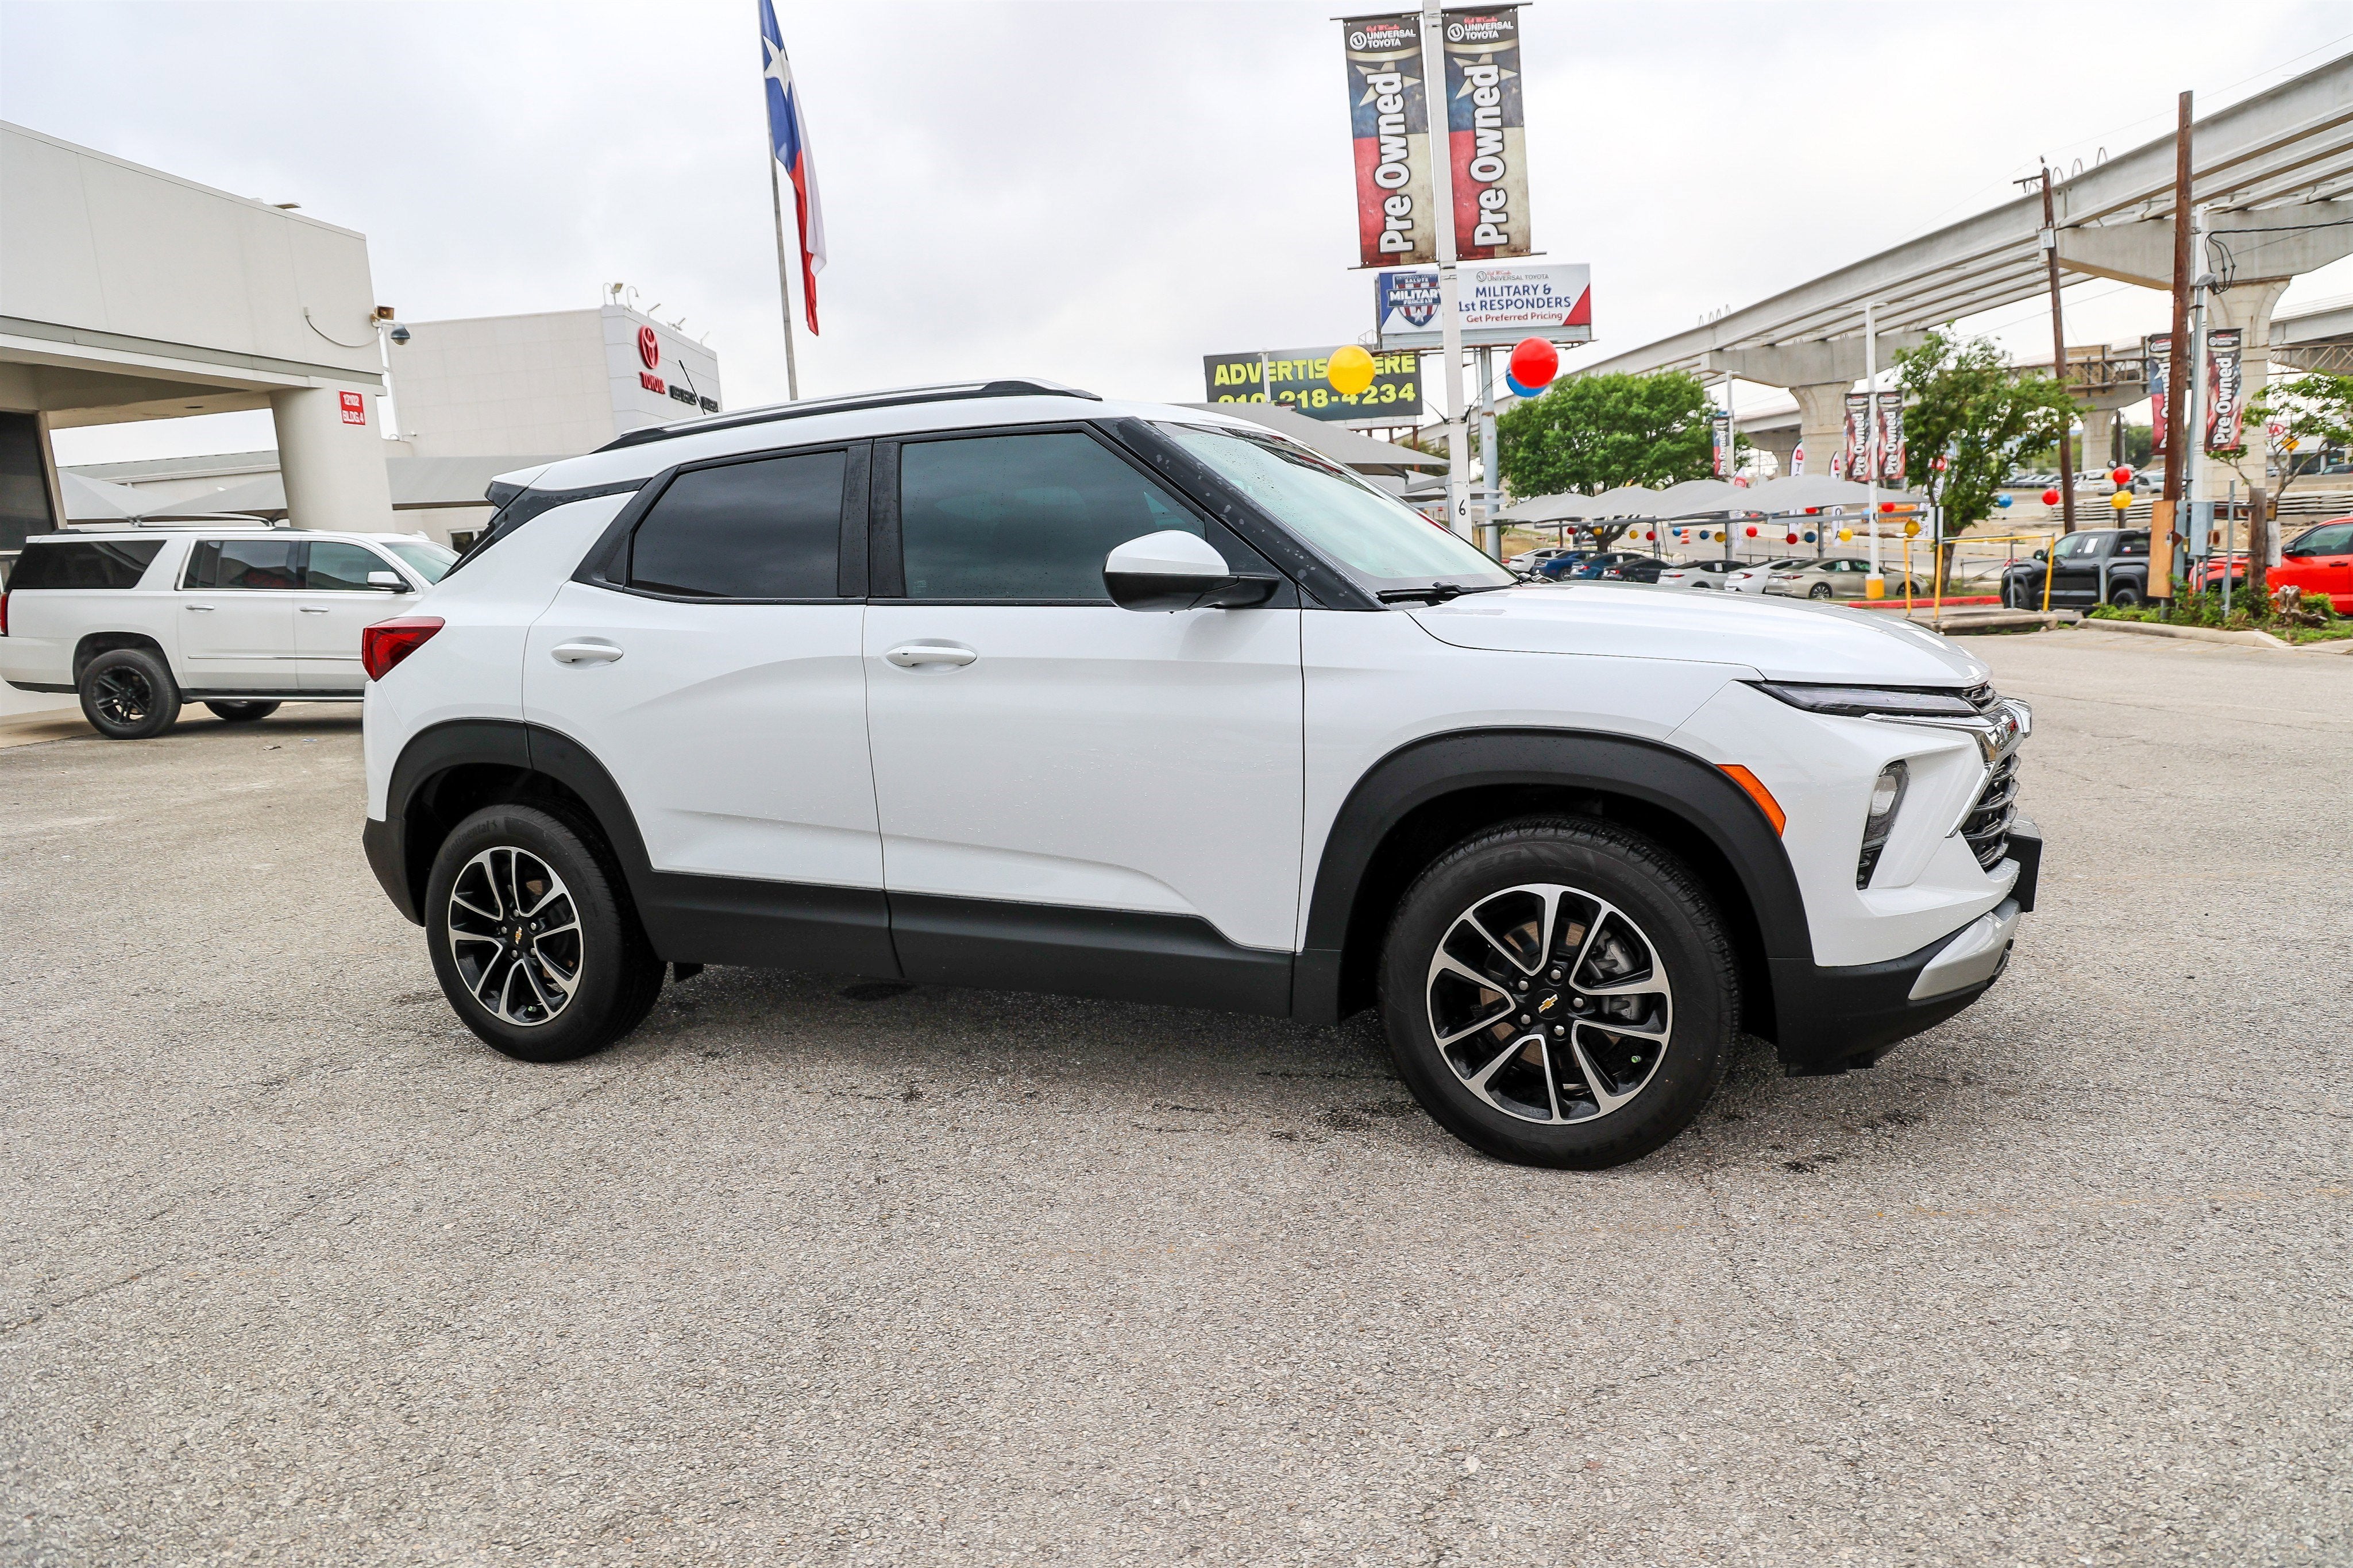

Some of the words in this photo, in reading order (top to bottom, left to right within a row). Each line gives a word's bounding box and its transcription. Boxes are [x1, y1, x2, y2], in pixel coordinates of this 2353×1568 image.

[1367, 29, 1416, 40] UNIVERSAL
[1464, 21, 1514, 32] UNIVERSAL
[1465, 30, 1499, 40] TOYOTA
[1368, 38, 1402, 48] TOYOTA
[1366, 72, 1410, 189] Owned
[1463, 64, 1506, 182] Owned
[1379, 194, 1414, 253] Pre
[1474, 188, 1509, 246] Pre
[1475, 283, 1540, 298] MILITARY
[1543, 283, 1552, 295] &
[1480, 295, 1571, 311] RESPONDERS
[1467, 315, 1483, 323] Get
[1486, 312, 1528, 322] Preferred
[1531, 311, 1563, 322] Pricing
[1214, 357, 1328, 386] ADVERTIS
[1375, 353, 1416, 376] ERE
[639, 370, 666, 395] TOYOTA
[2215, 357, 2233, 414] Owned
[1851, 412, 1866, 455] Owned
[1883, 411, 1897, 453] Owned
[2212, 416, 2231, 444] Pre
[1851, 455, 1866, 477] Pre
[1884, 454, 1897, 476] Pre
[1459, 499, 1466, 516] 6
